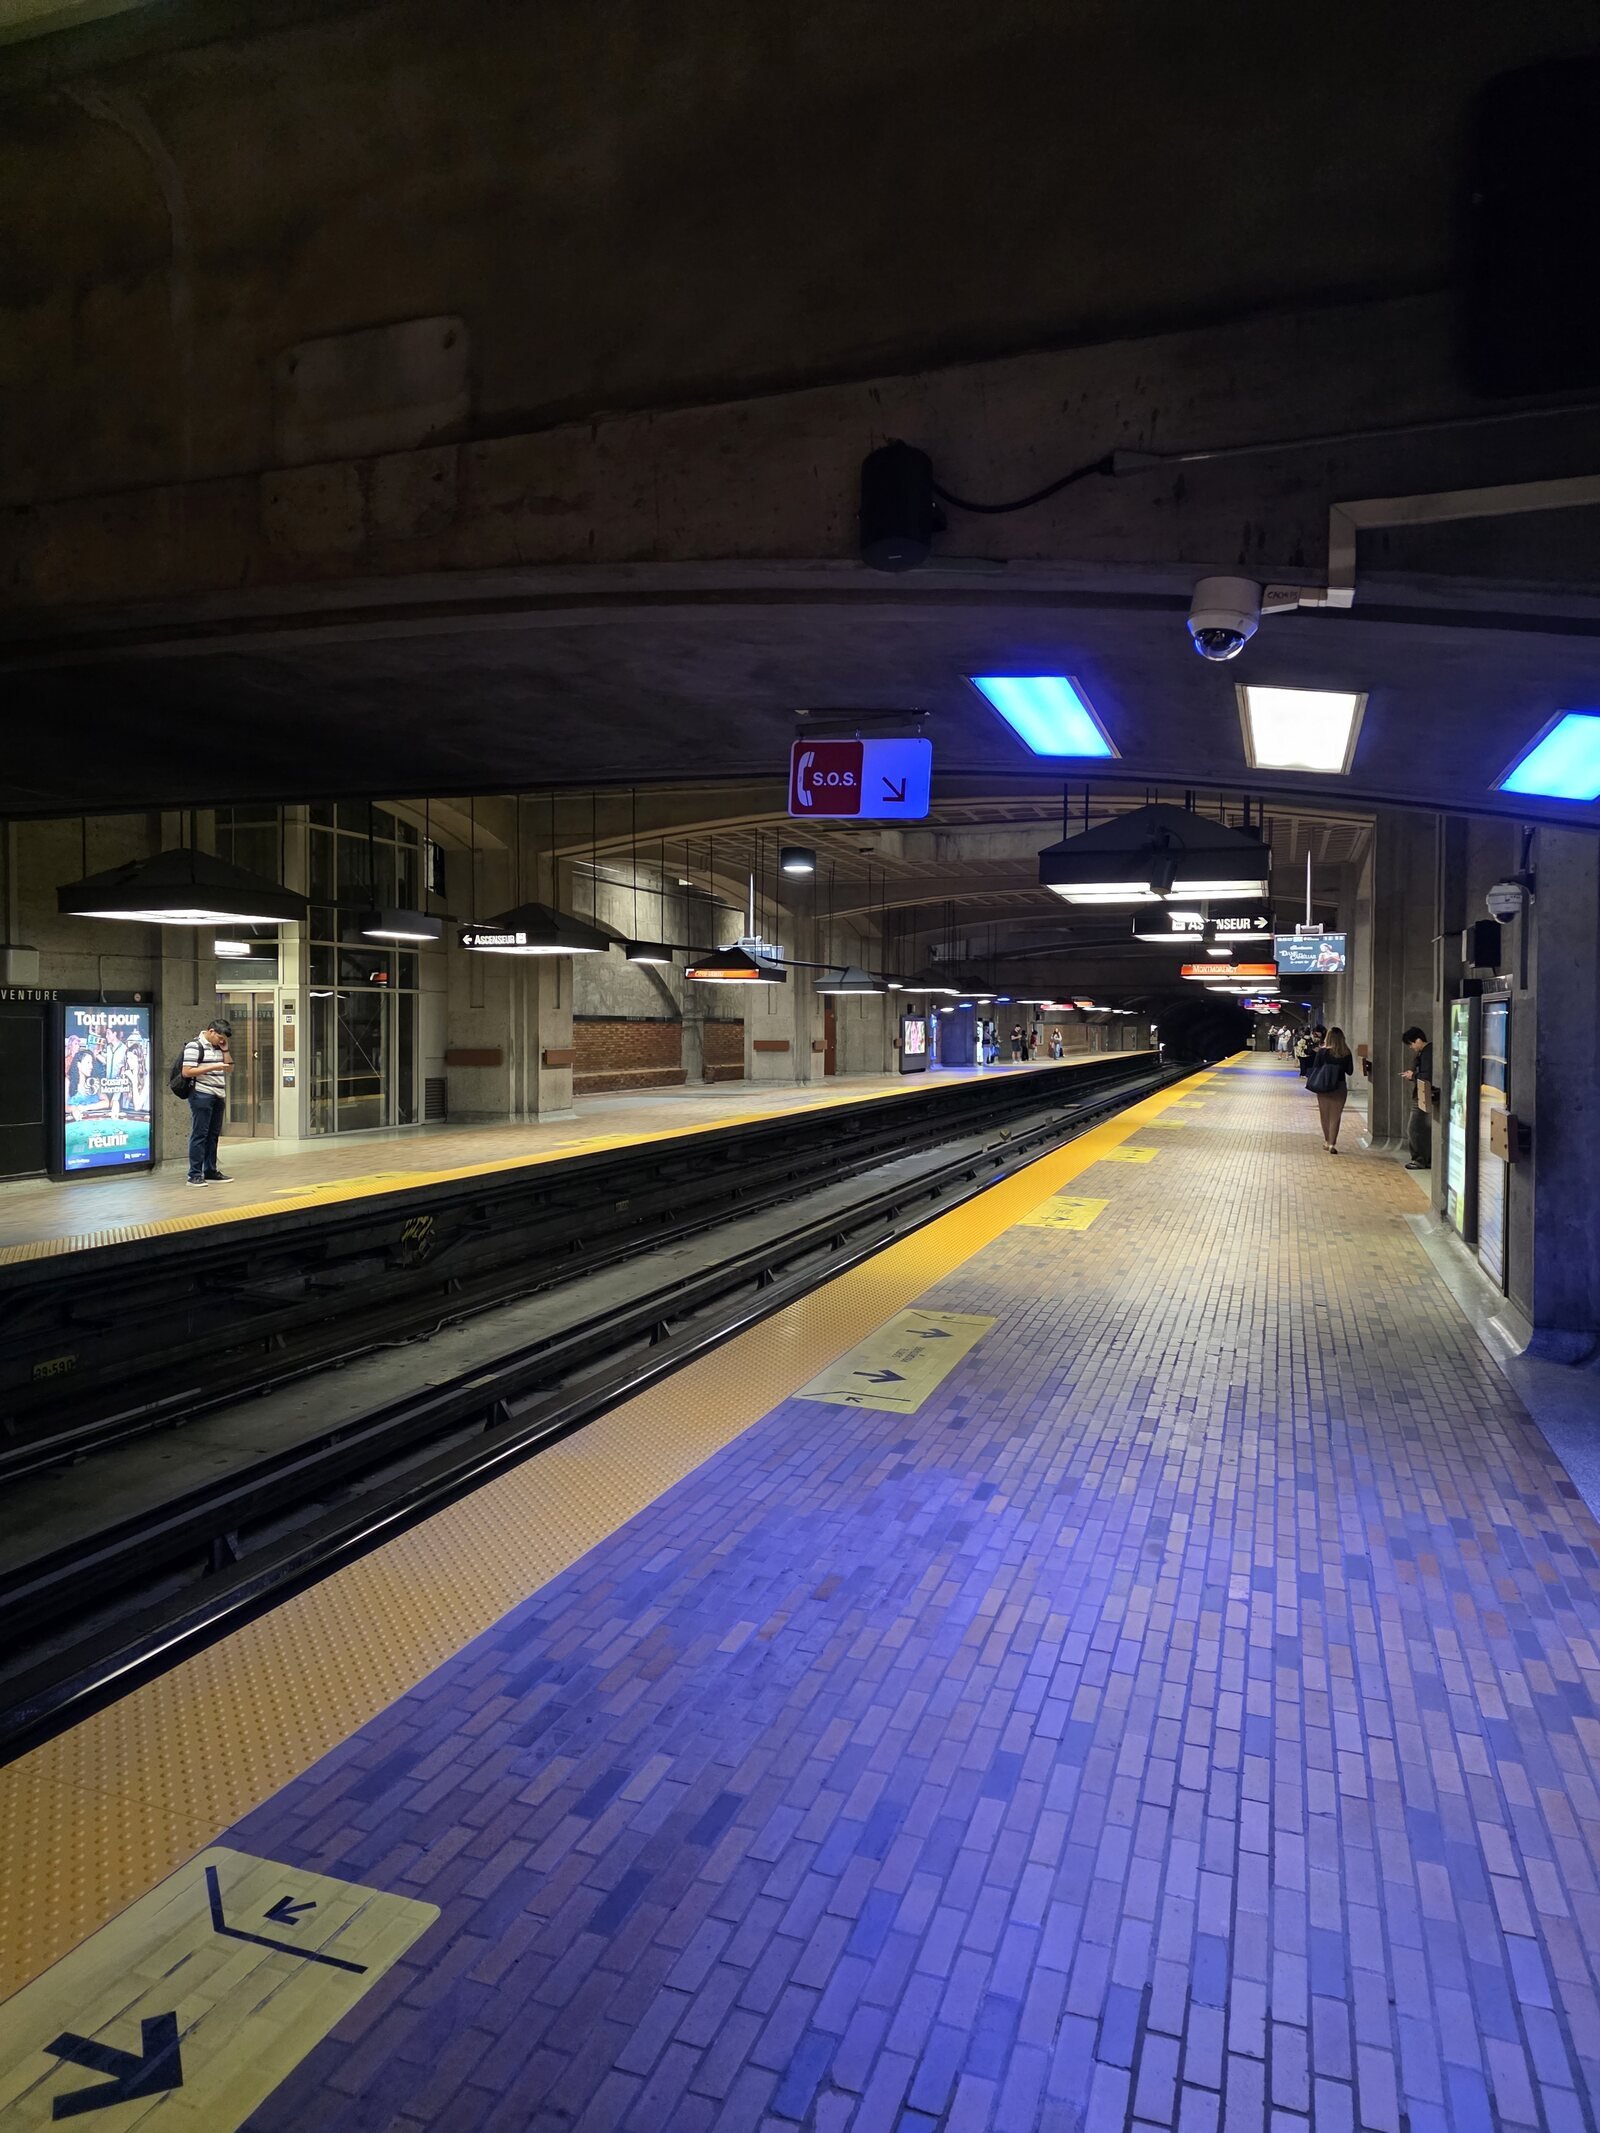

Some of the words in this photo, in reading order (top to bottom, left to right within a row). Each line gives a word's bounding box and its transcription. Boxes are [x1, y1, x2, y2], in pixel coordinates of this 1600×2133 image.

[813, 771, 857, 786] S.O.S.
[474, 934, 515, 945] ASCENSEUR
[74, 1011, 106, 1026] Tout
[108, 1013, 140, 1028] pour
[100, 1077, 129, 1087] Casino
[88, 1130, 129, 1149] réunir
